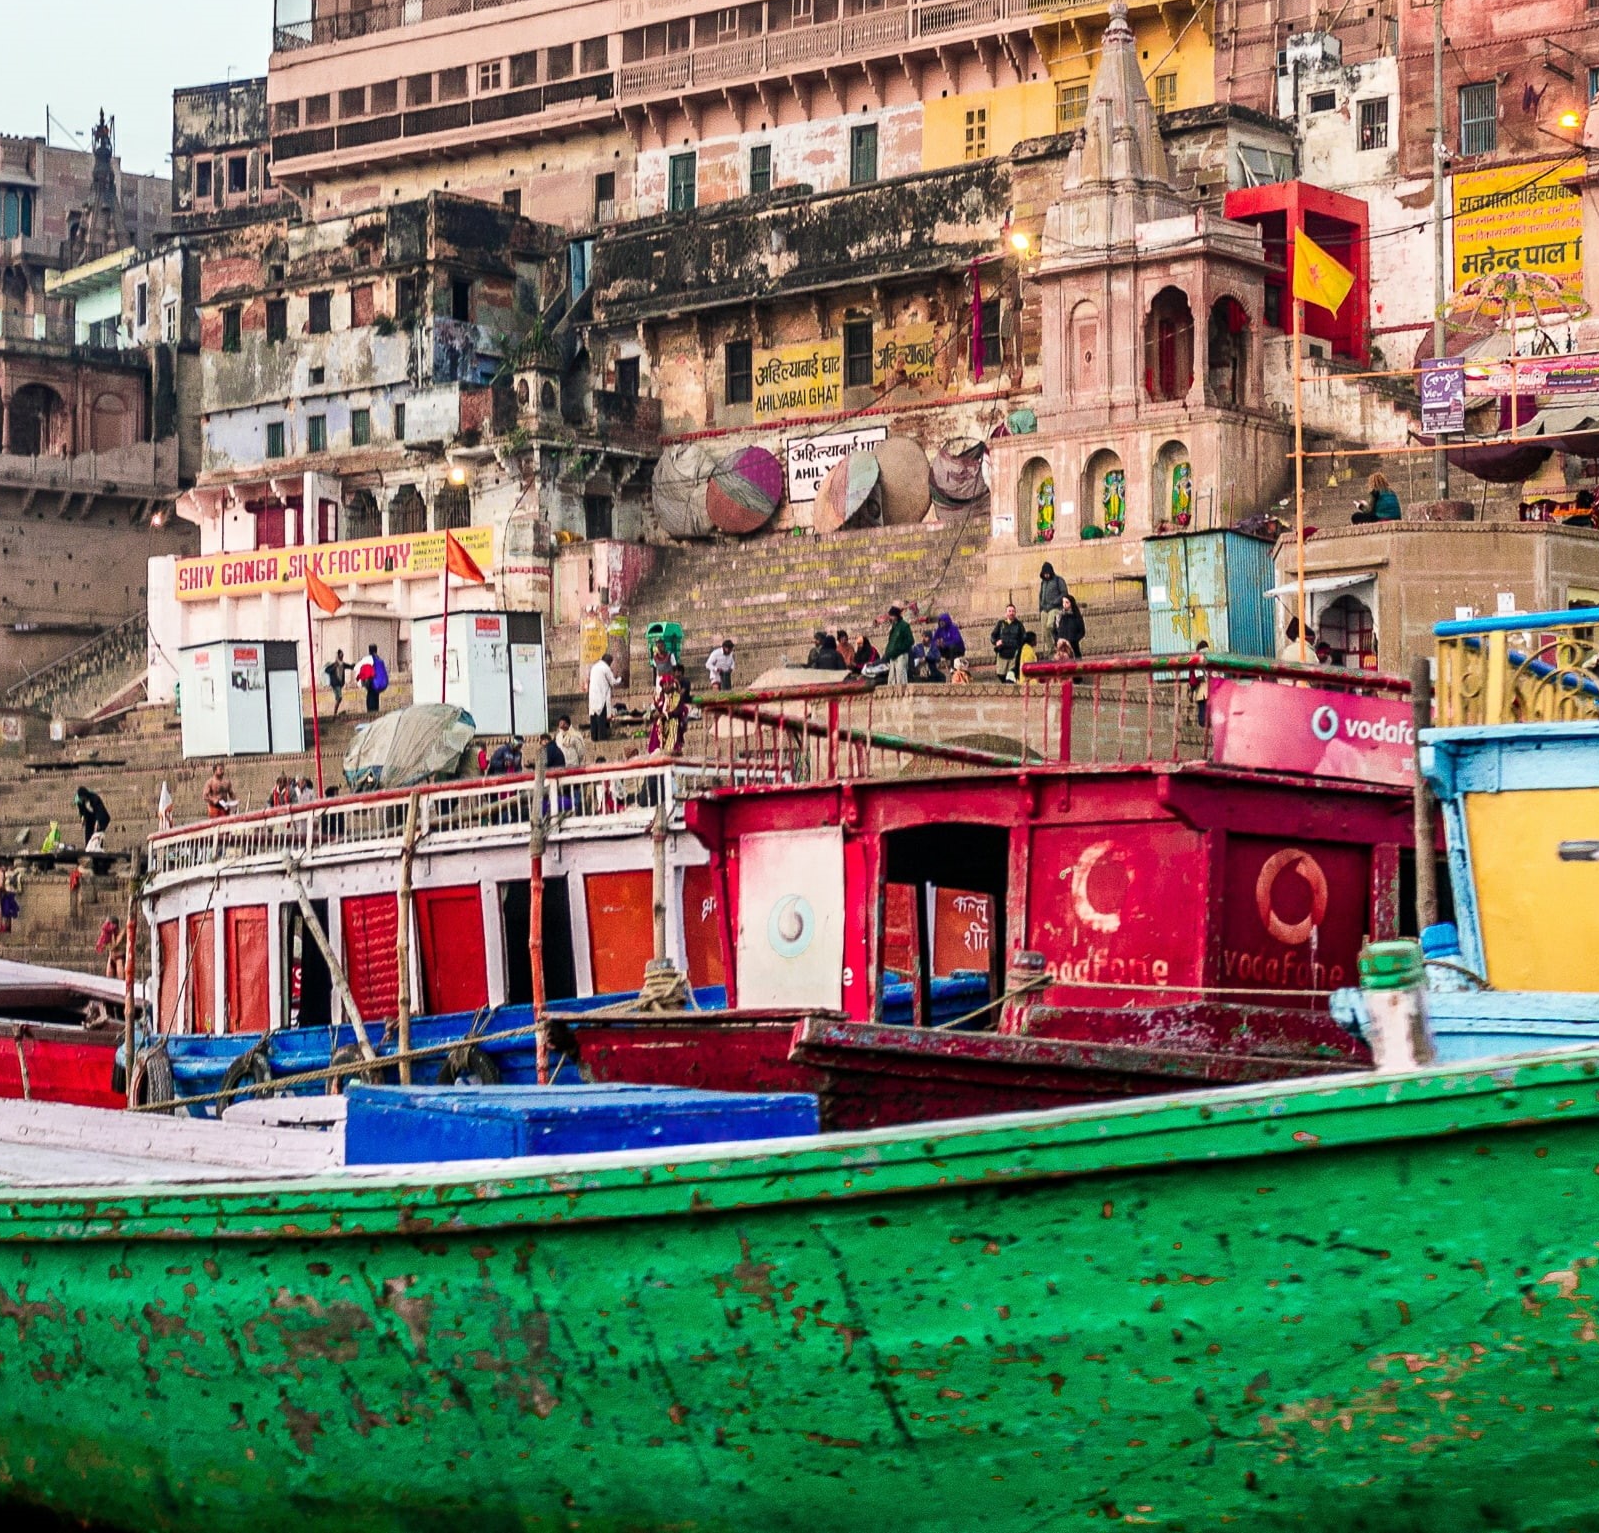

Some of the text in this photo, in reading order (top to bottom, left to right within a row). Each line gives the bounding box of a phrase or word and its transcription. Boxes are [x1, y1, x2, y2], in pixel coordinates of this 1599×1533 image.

[1523, 241, 1568, 266] पाल
[755, 352, 841, 387] अहिल्याबाई घाट
[755, 384, 840, 413] AHILYABAI GHAT
[179, 565, 214, 591] SHIV
[221, 557, 279, 586] GANGA
[288, 551, 325, 579] SILK
[328, 541, 411, 575] FACTORY
[1345, 717, 1415, 745] vodafo
[1045, 948, 1169, 987] odafone
[1224, 948, 1346, 989] vodafone
